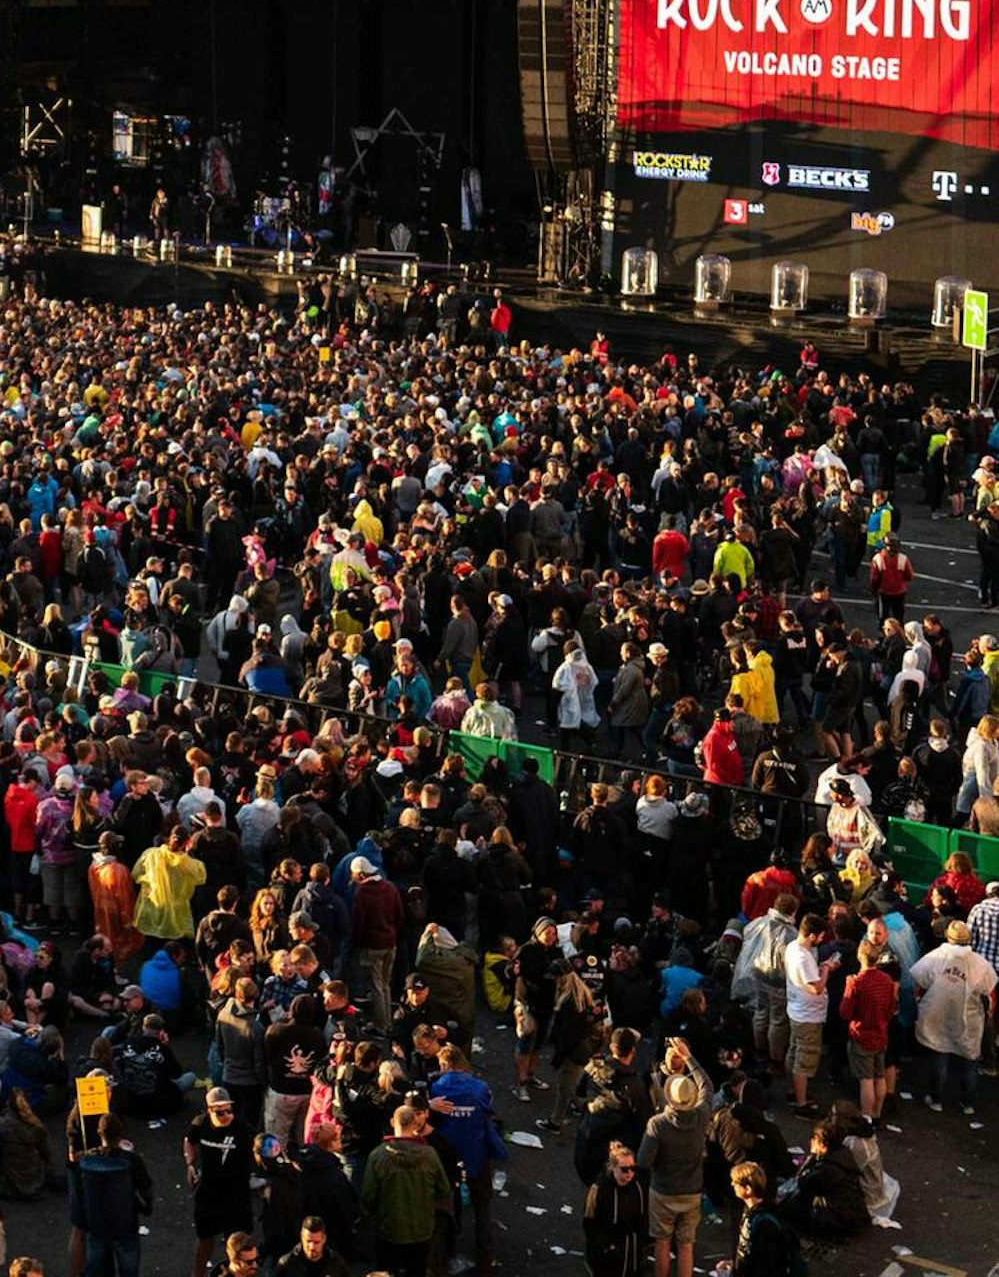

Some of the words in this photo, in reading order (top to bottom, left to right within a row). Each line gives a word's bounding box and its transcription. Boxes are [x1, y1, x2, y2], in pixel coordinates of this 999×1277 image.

[723, 50, 823, 76] VOLCANO
[831, 55, 900, 81] STAGE
[633, 151, 711, 171] ROCKSTAR
[635, 165, 675, 180] ENERGY
[676, 169, 709, 182] DRINK
[788, 168, 870, 188] BECK'S
